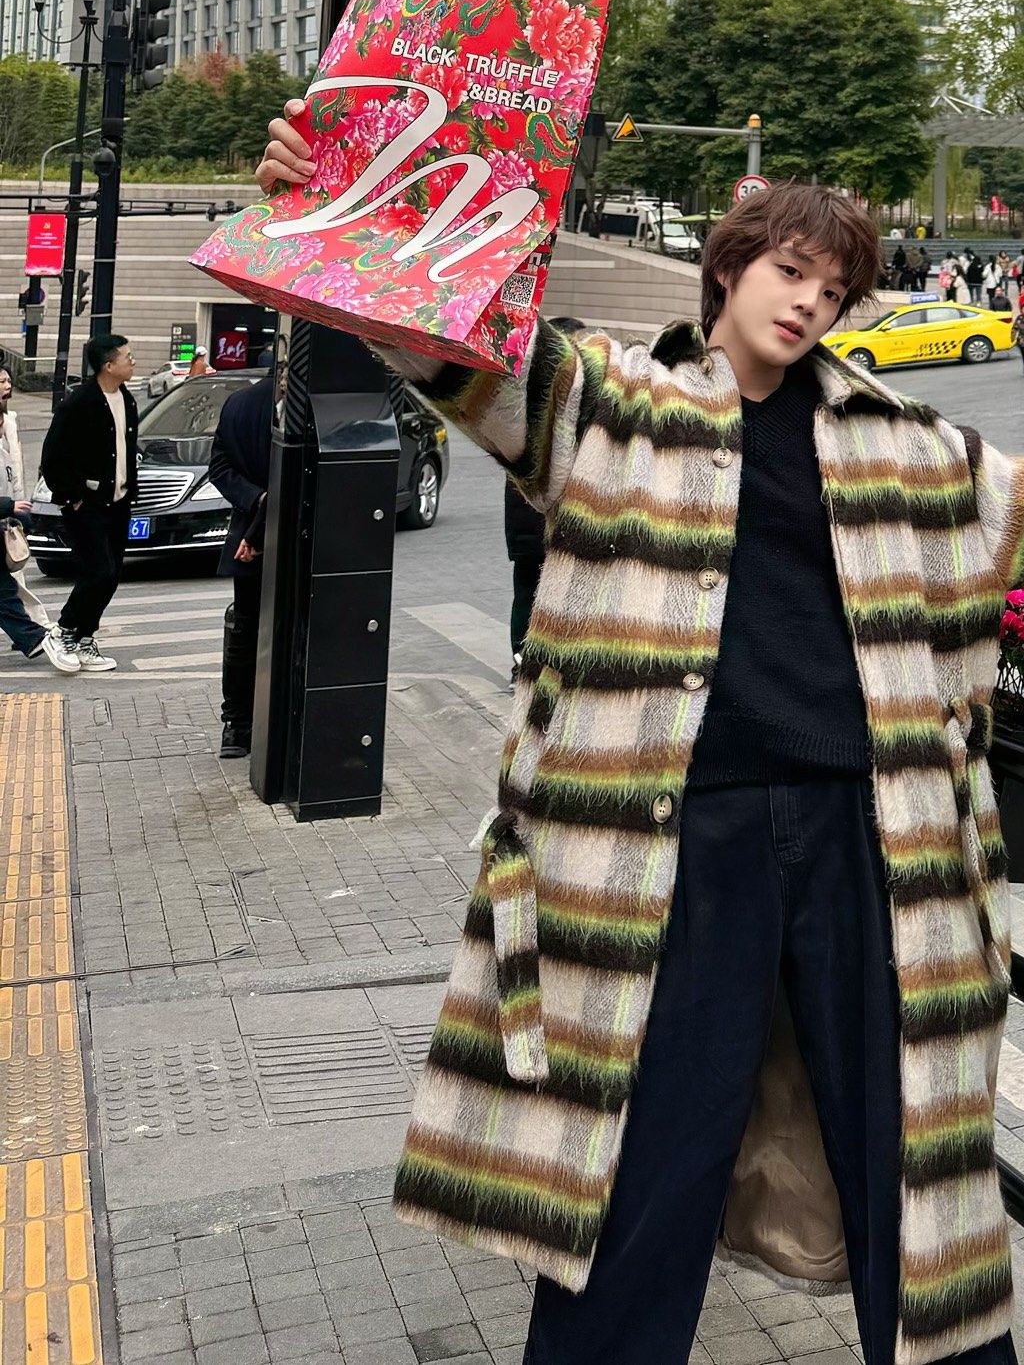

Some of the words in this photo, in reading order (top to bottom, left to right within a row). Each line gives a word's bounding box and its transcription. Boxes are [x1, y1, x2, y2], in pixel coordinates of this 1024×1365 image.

[390, 38, 456, 68] BLACK
[465, 53, 559, 89] TRUFFLE
[469, 83, 552, 114] &BREAD
